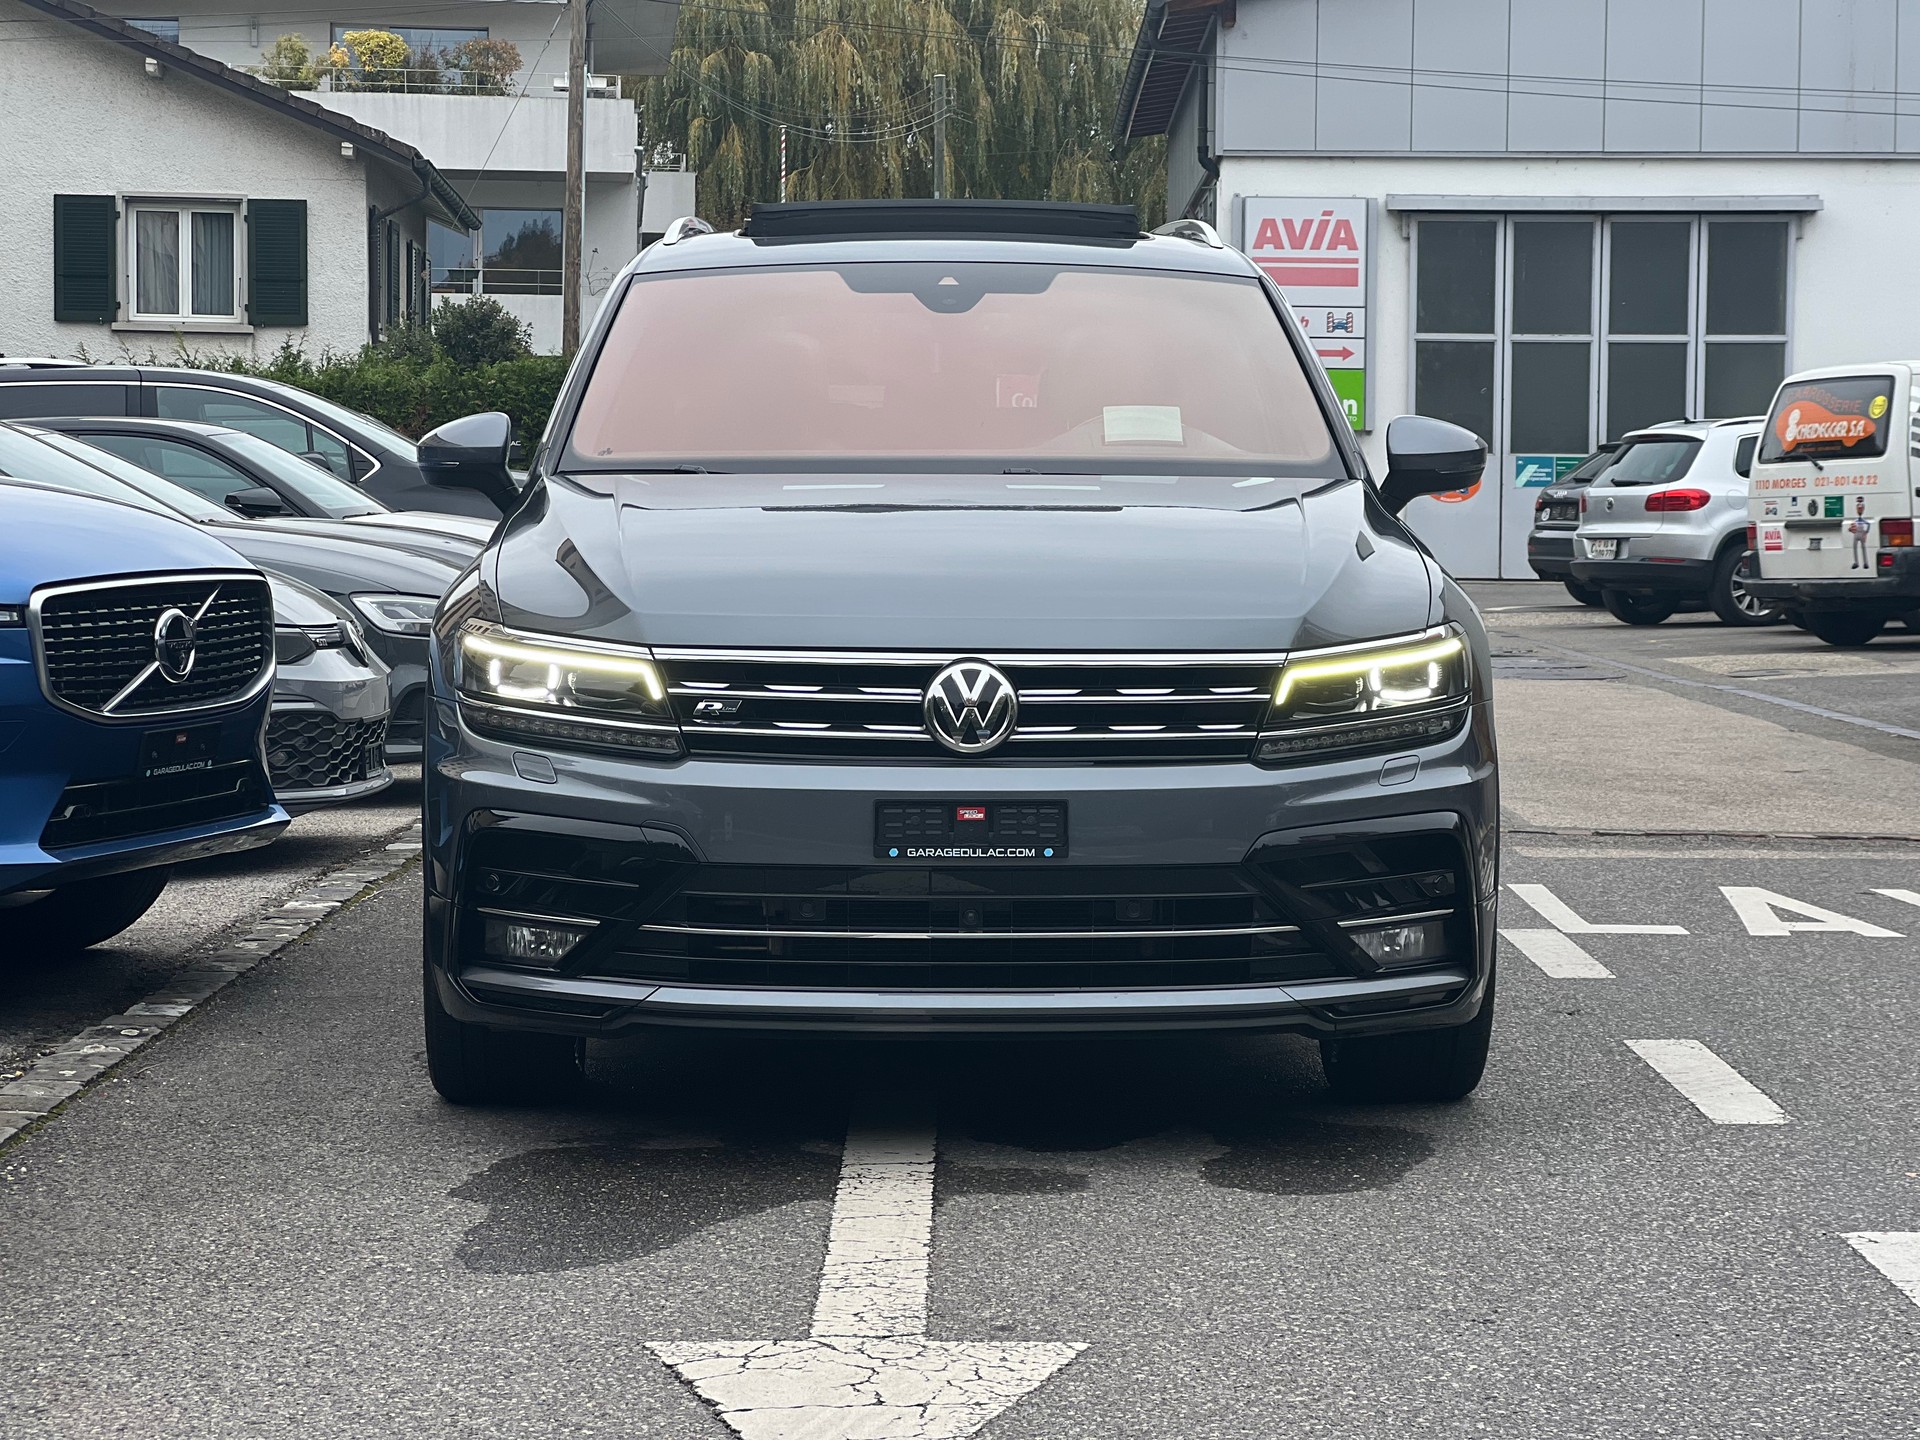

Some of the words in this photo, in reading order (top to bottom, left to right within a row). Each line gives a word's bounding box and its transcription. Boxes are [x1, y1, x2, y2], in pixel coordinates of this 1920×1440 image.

[1755, 479, 1770, 490] 1110
[1771, 477, 1807, 489] MORGES
[153, 760, 206, 776] GARAGEDULAC.COM
[907, 848, 1036, 857] GARAGEDULAC.COM
